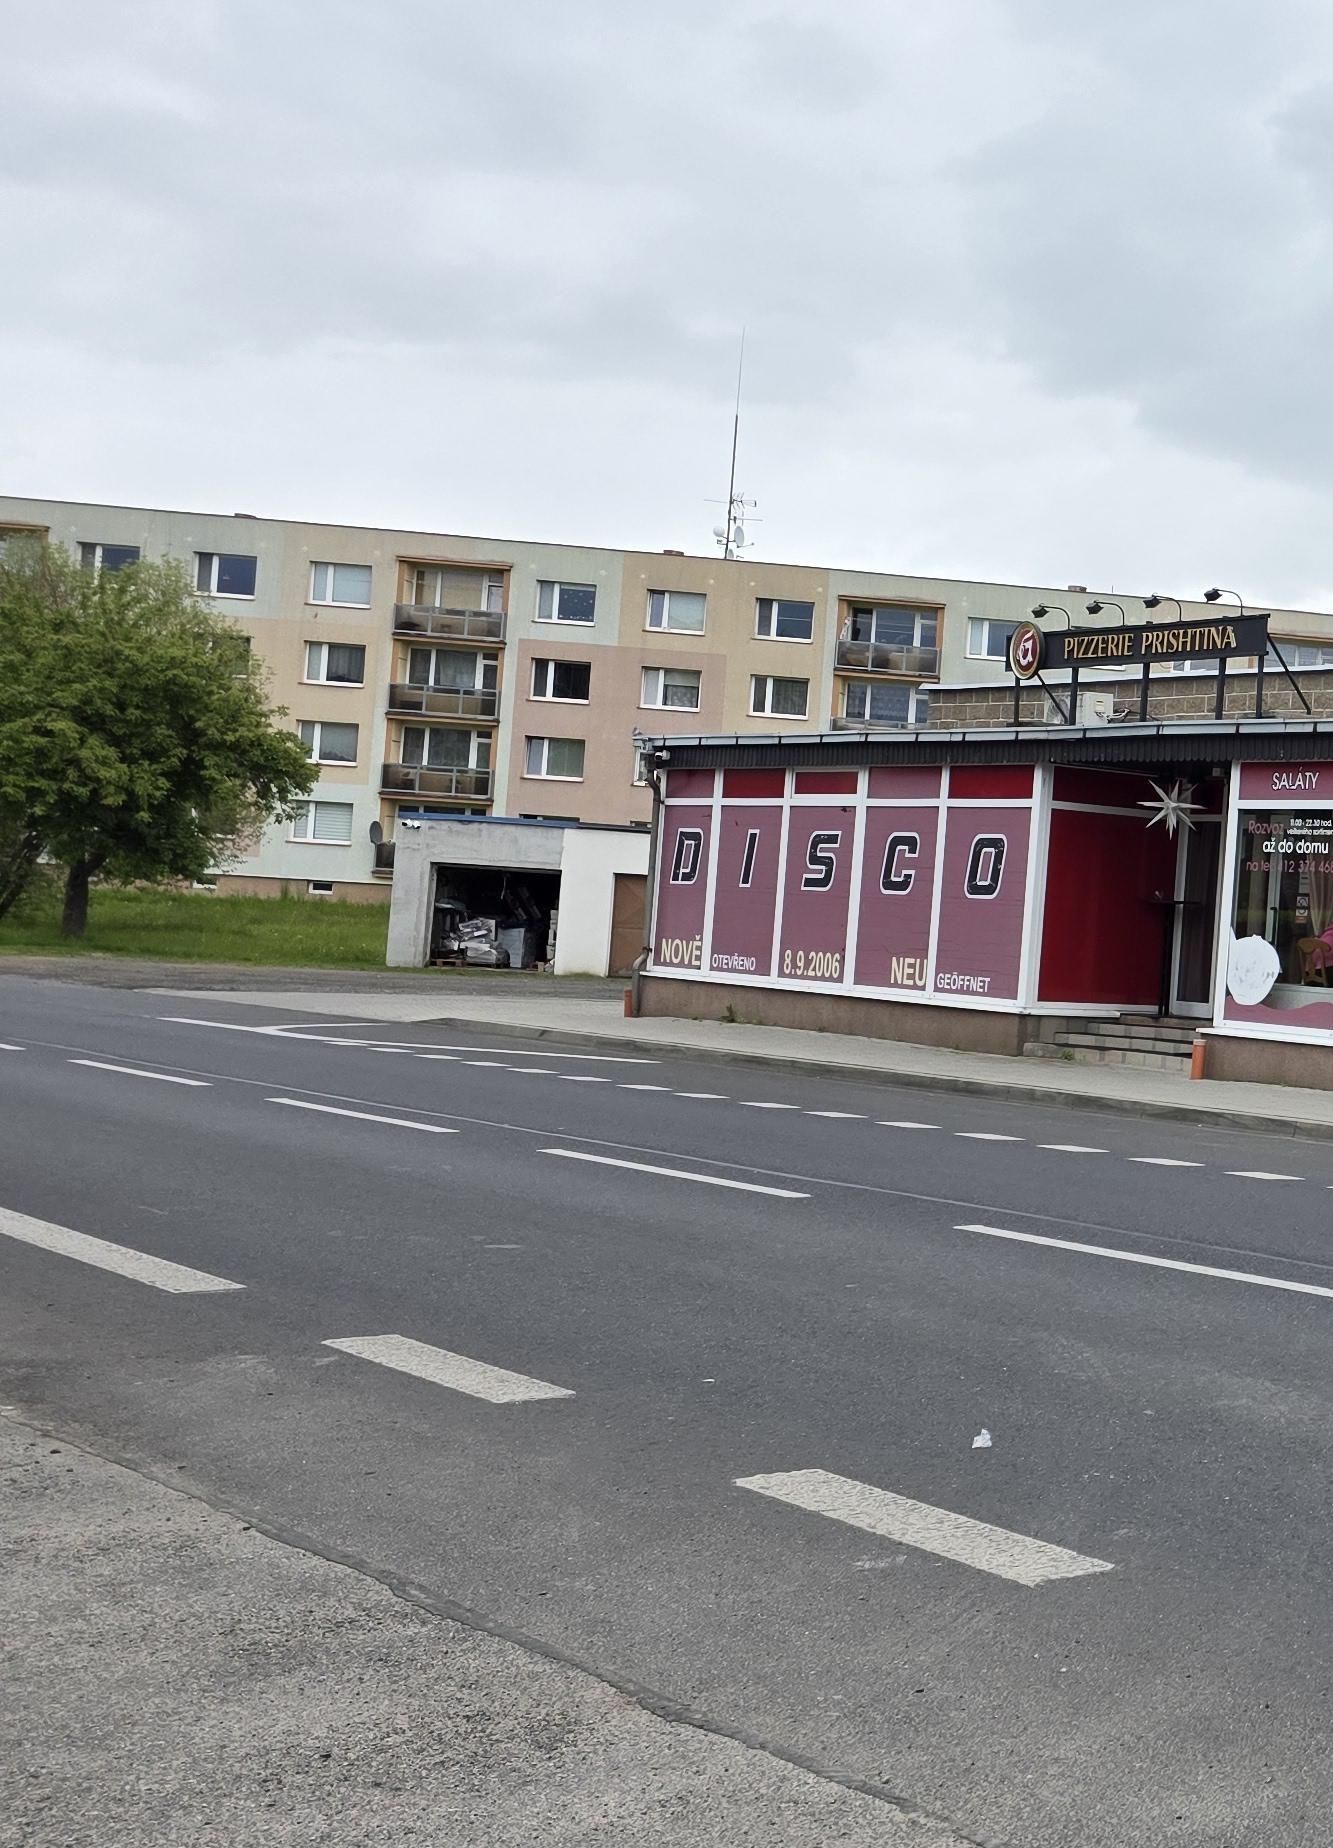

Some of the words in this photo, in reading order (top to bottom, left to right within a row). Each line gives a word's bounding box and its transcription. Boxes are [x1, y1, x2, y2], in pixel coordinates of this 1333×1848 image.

[1064, 633, 1134, 660] PIZZERIE
[1141, 625, 1238, 655] PRISHTINA
[1271, 766, 1320, 791] SALÁTY
[1248, 820, 1284, 834] Rozvoz
[1262, 837, 1276, 853] až
[1278, 838, 1294, 854] do
[1295, 839, 1329, 854] domu
[669, 826, 1008, 900] DISCO
[1246, 861, 1259, 871] na
[1298, 860, 1316, 873] 374
[660, 934, 702, 966] NOVĚ
[711, 952, 757, 971] OTEVŘENO
[783, 948, 841, 979] 8.9.2006
[890, 956, 928, 987] NEU
[936, 971, 991, 993] GEÖFFNET
